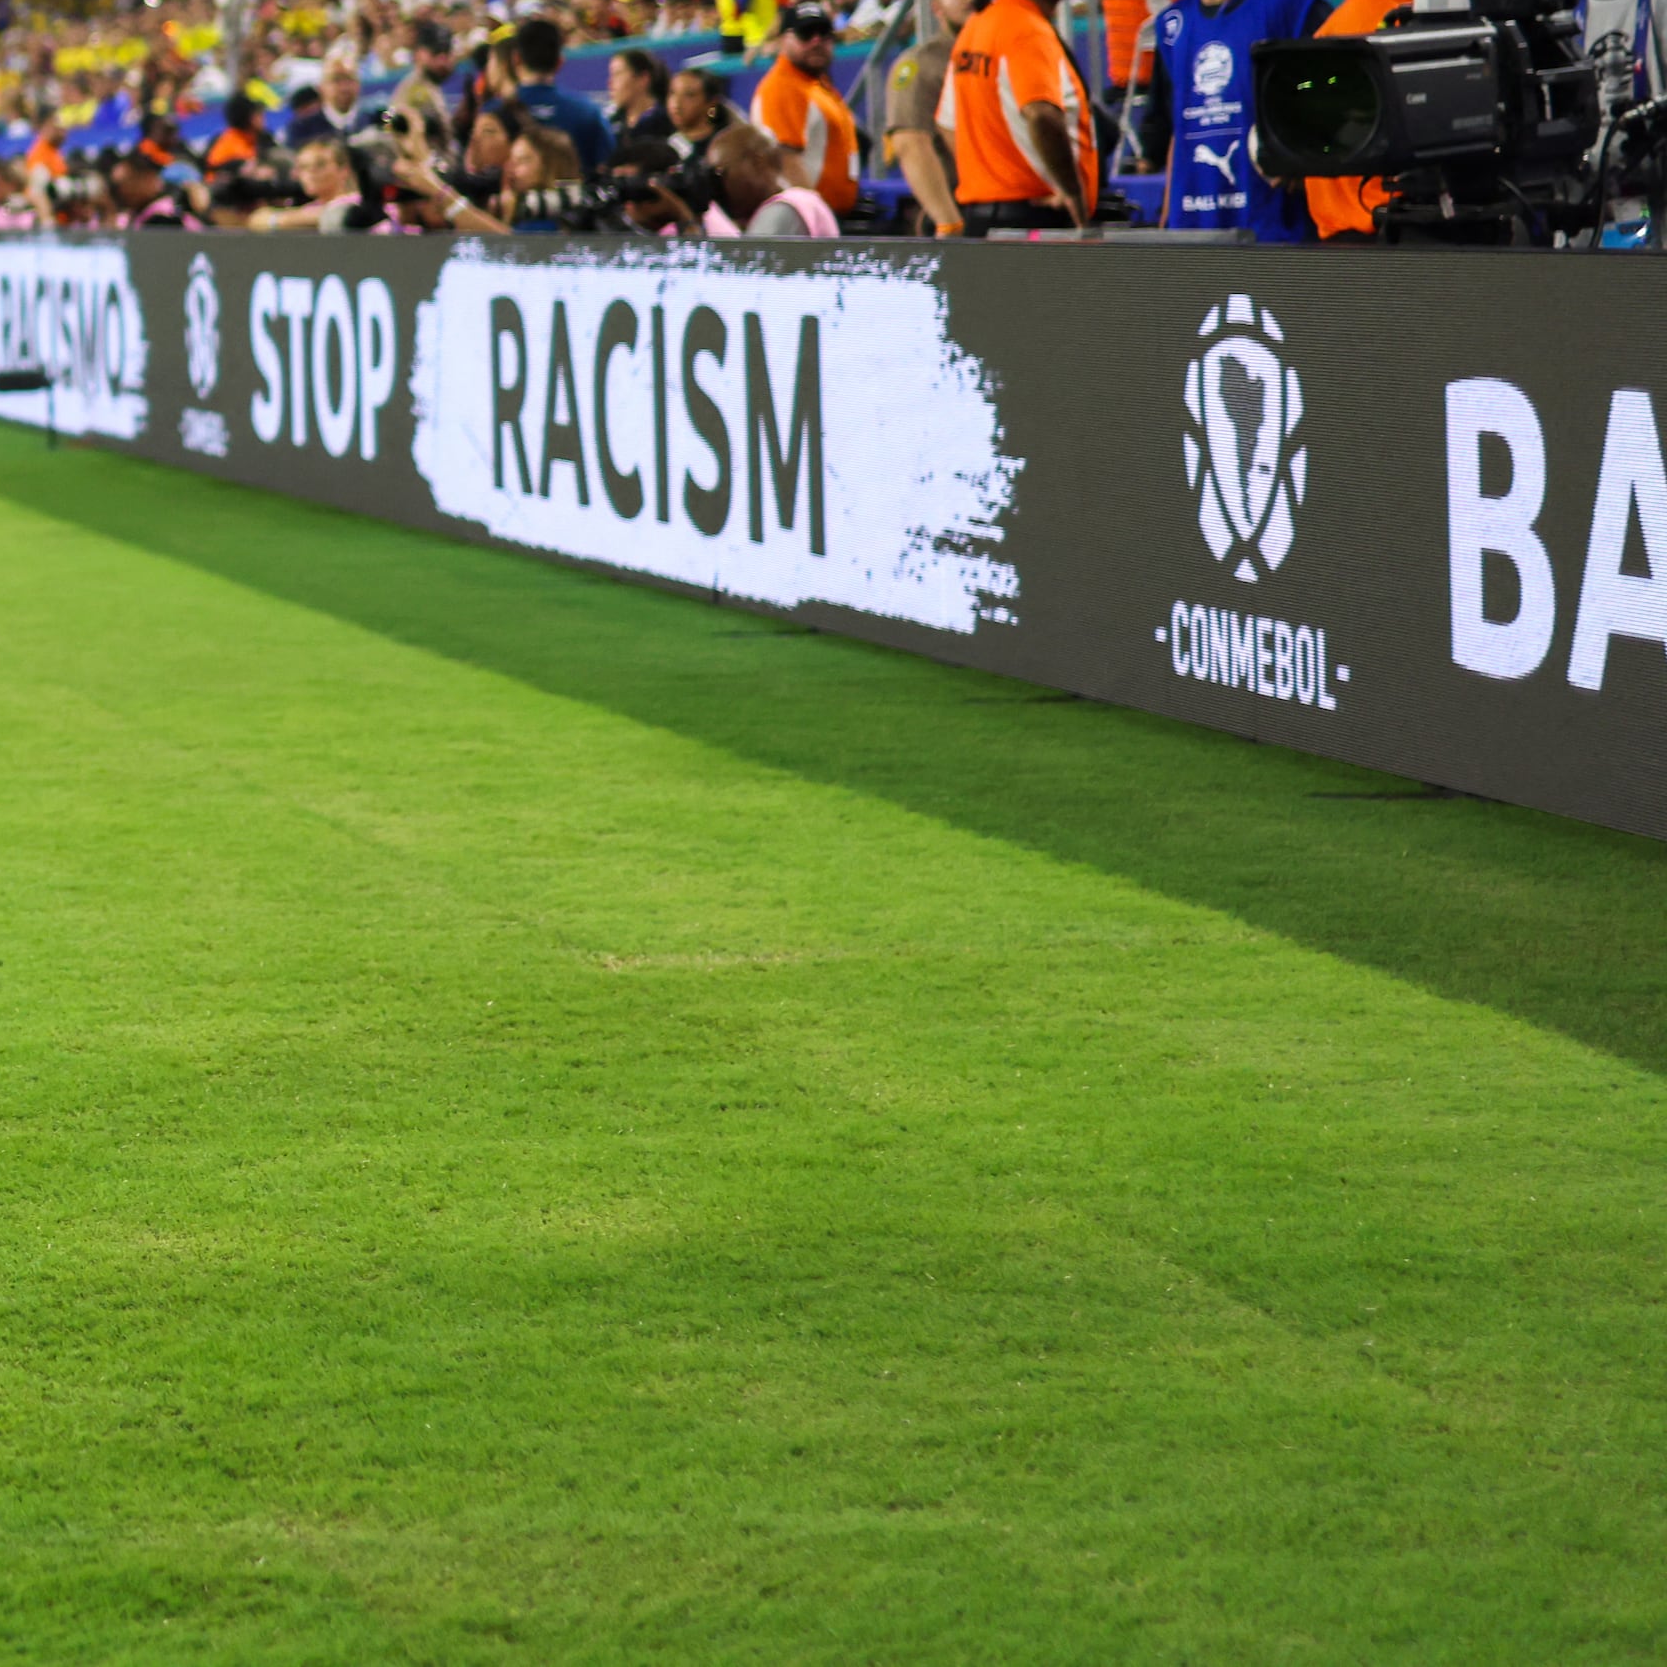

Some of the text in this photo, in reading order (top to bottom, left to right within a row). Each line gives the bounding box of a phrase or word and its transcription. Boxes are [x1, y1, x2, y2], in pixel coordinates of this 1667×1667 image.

[249, 270, 398, 462] STOP
[489, 292, 827, 557] RACISM
[1170, 599, 1338, 711] CONMEBOL
